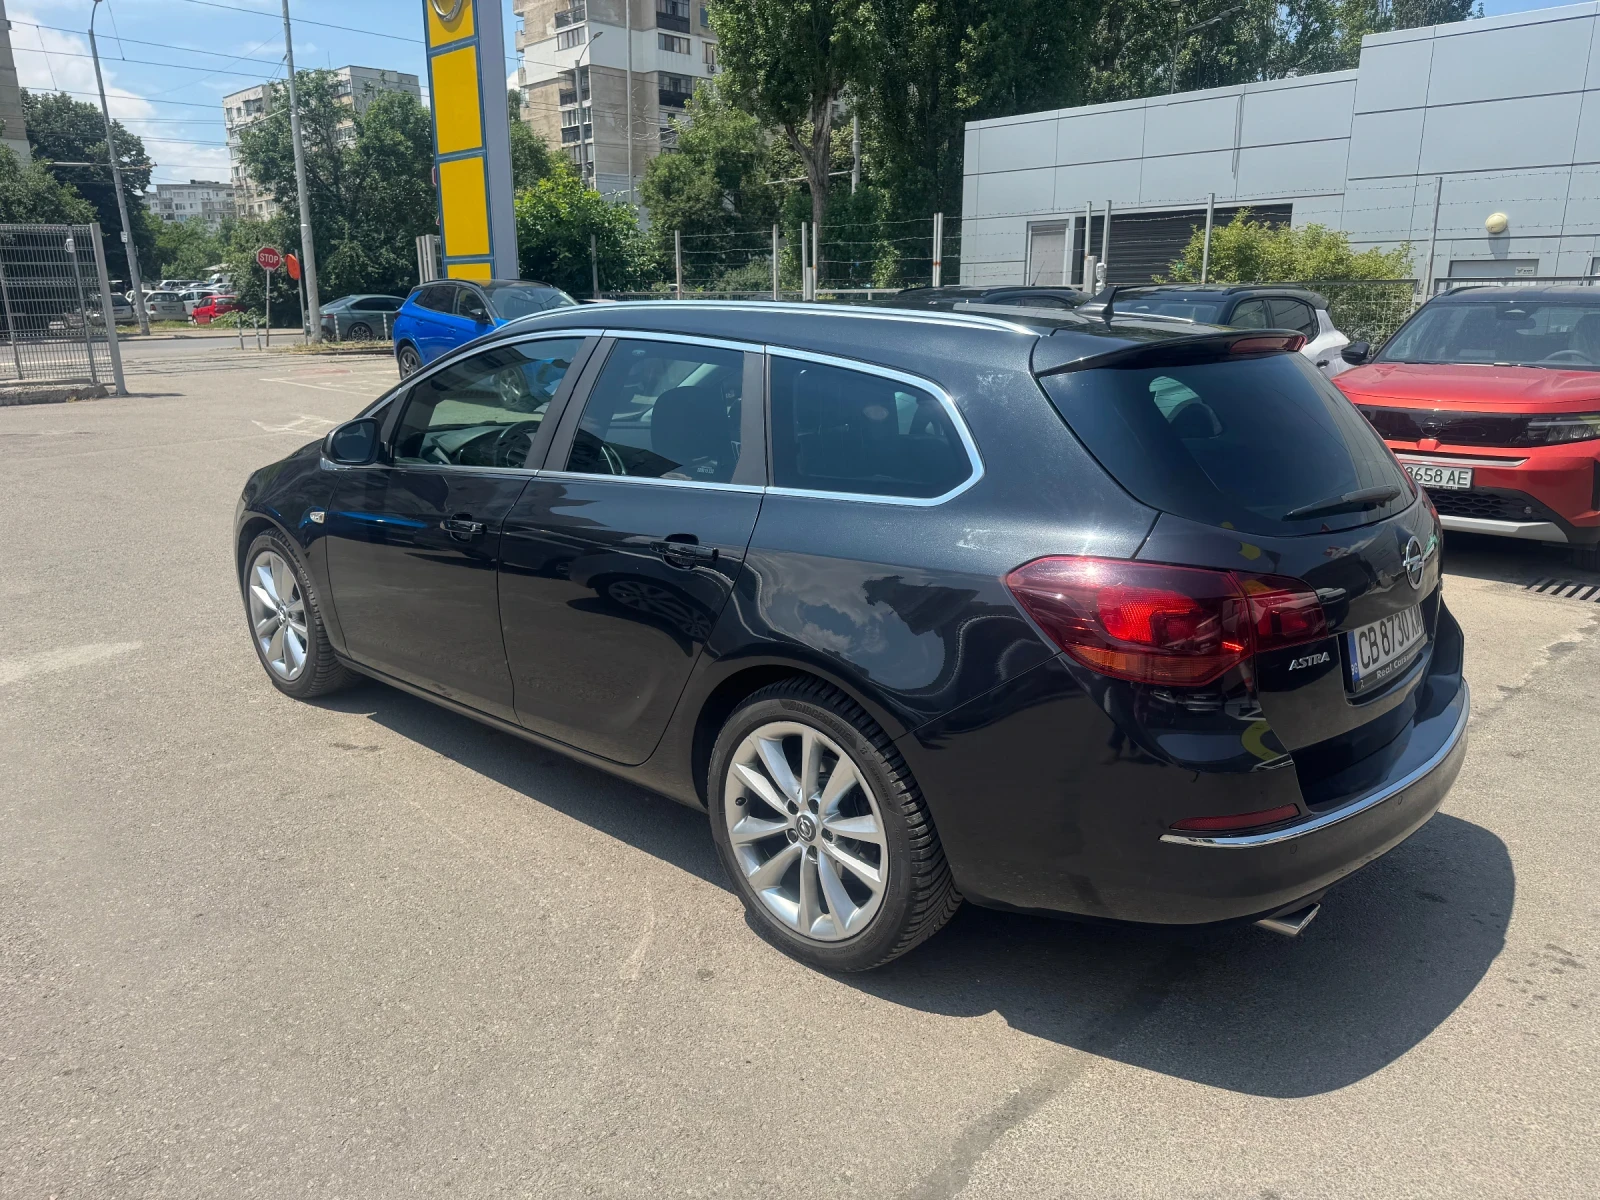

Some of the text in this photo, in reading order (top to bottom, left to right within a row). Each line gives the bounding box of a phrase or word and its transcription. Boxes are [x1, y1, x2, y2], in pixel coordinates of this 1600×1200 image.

[260, 253, 279, 264] STOP
[1446, 470, 1469, 486] AE
[1358, 626, 1380, 670] CB
[1380, 611, 1410, 657] 8730
[1288, 651, 1331, 672] ASTRA
[1376, 663, 1393, 679] Real
